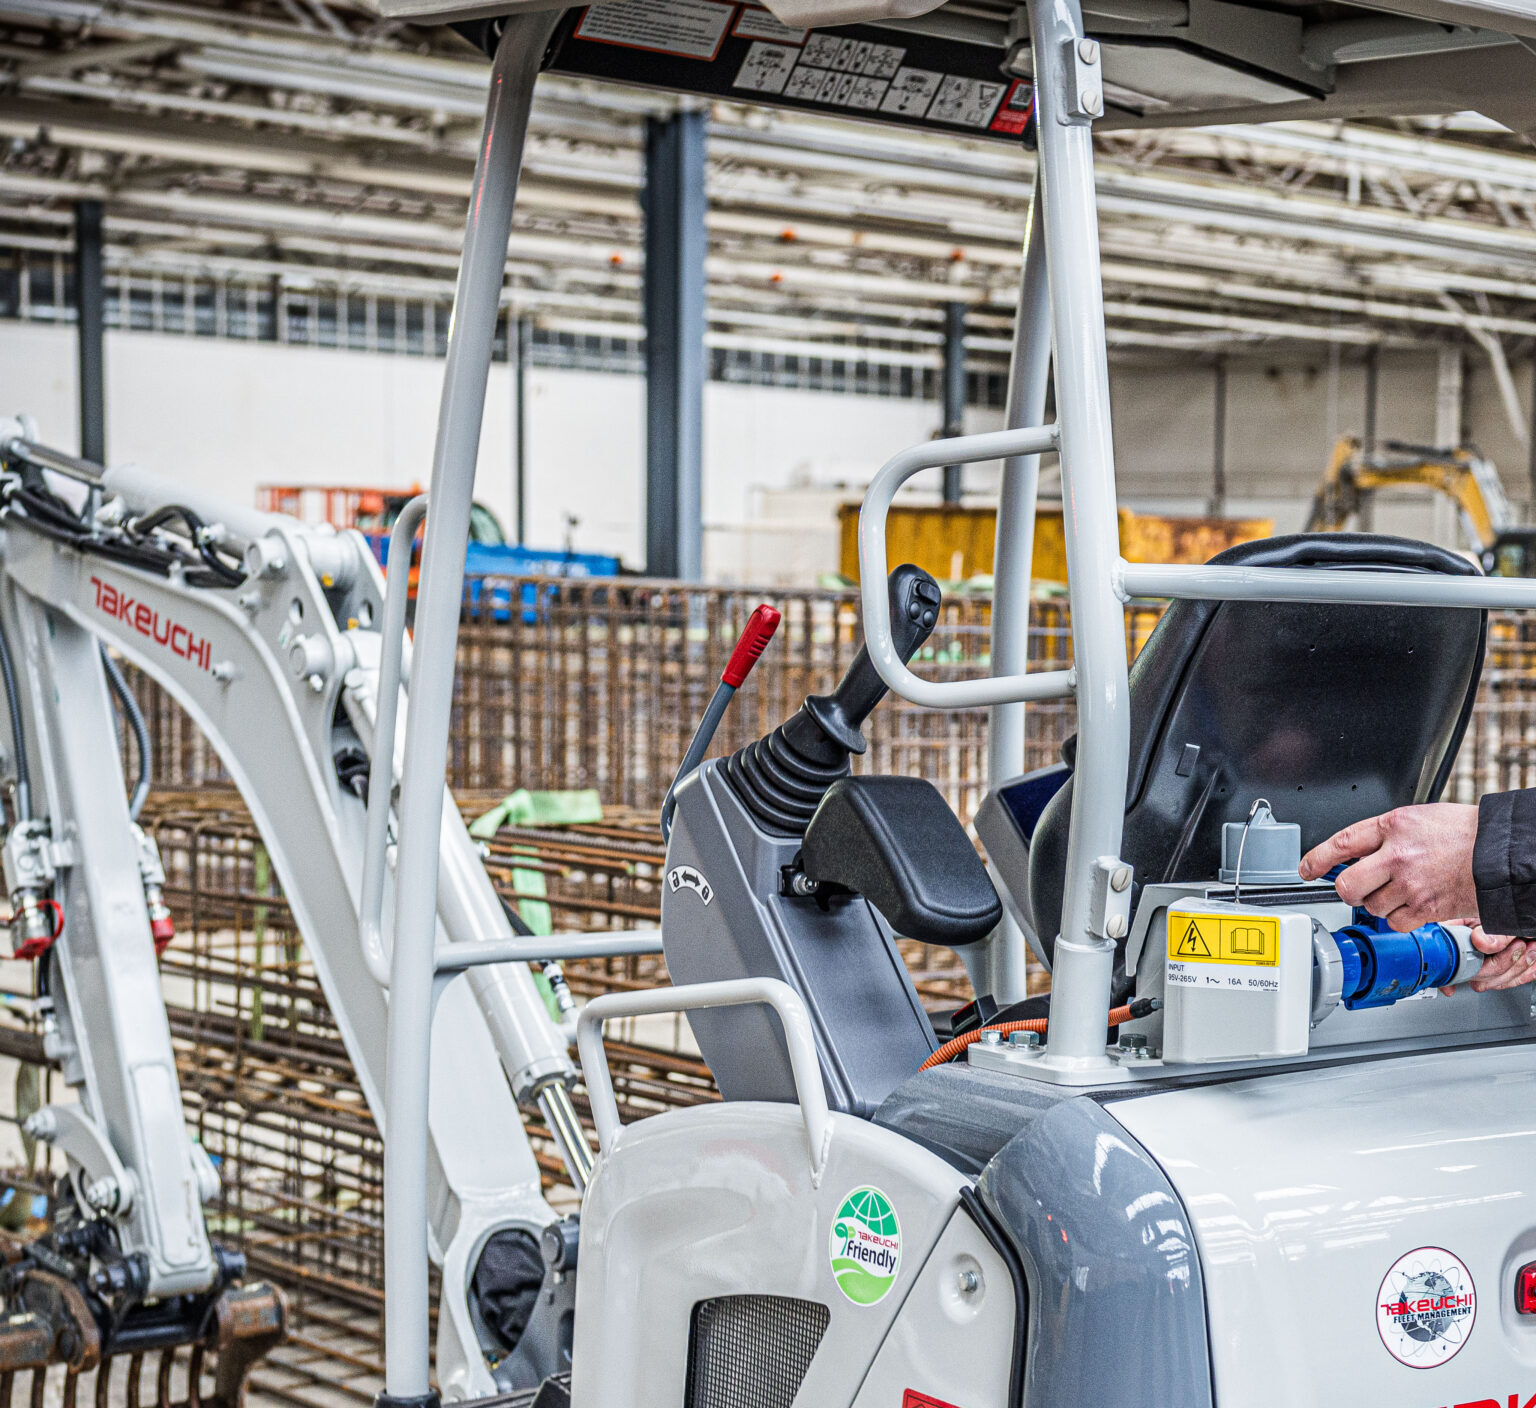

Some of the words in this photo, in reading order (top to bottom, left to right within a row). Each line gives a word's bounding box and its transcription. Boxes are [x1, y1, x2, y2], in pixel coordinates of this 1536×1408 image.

[1168, 963, 1184, 972] INPUT
[1248, 979, 1278, 988] 50/60Hz
[1393, 1314, 1416, 1324] FLEET
[1417, 1306, 1472, 1321] MANAGEMENT
